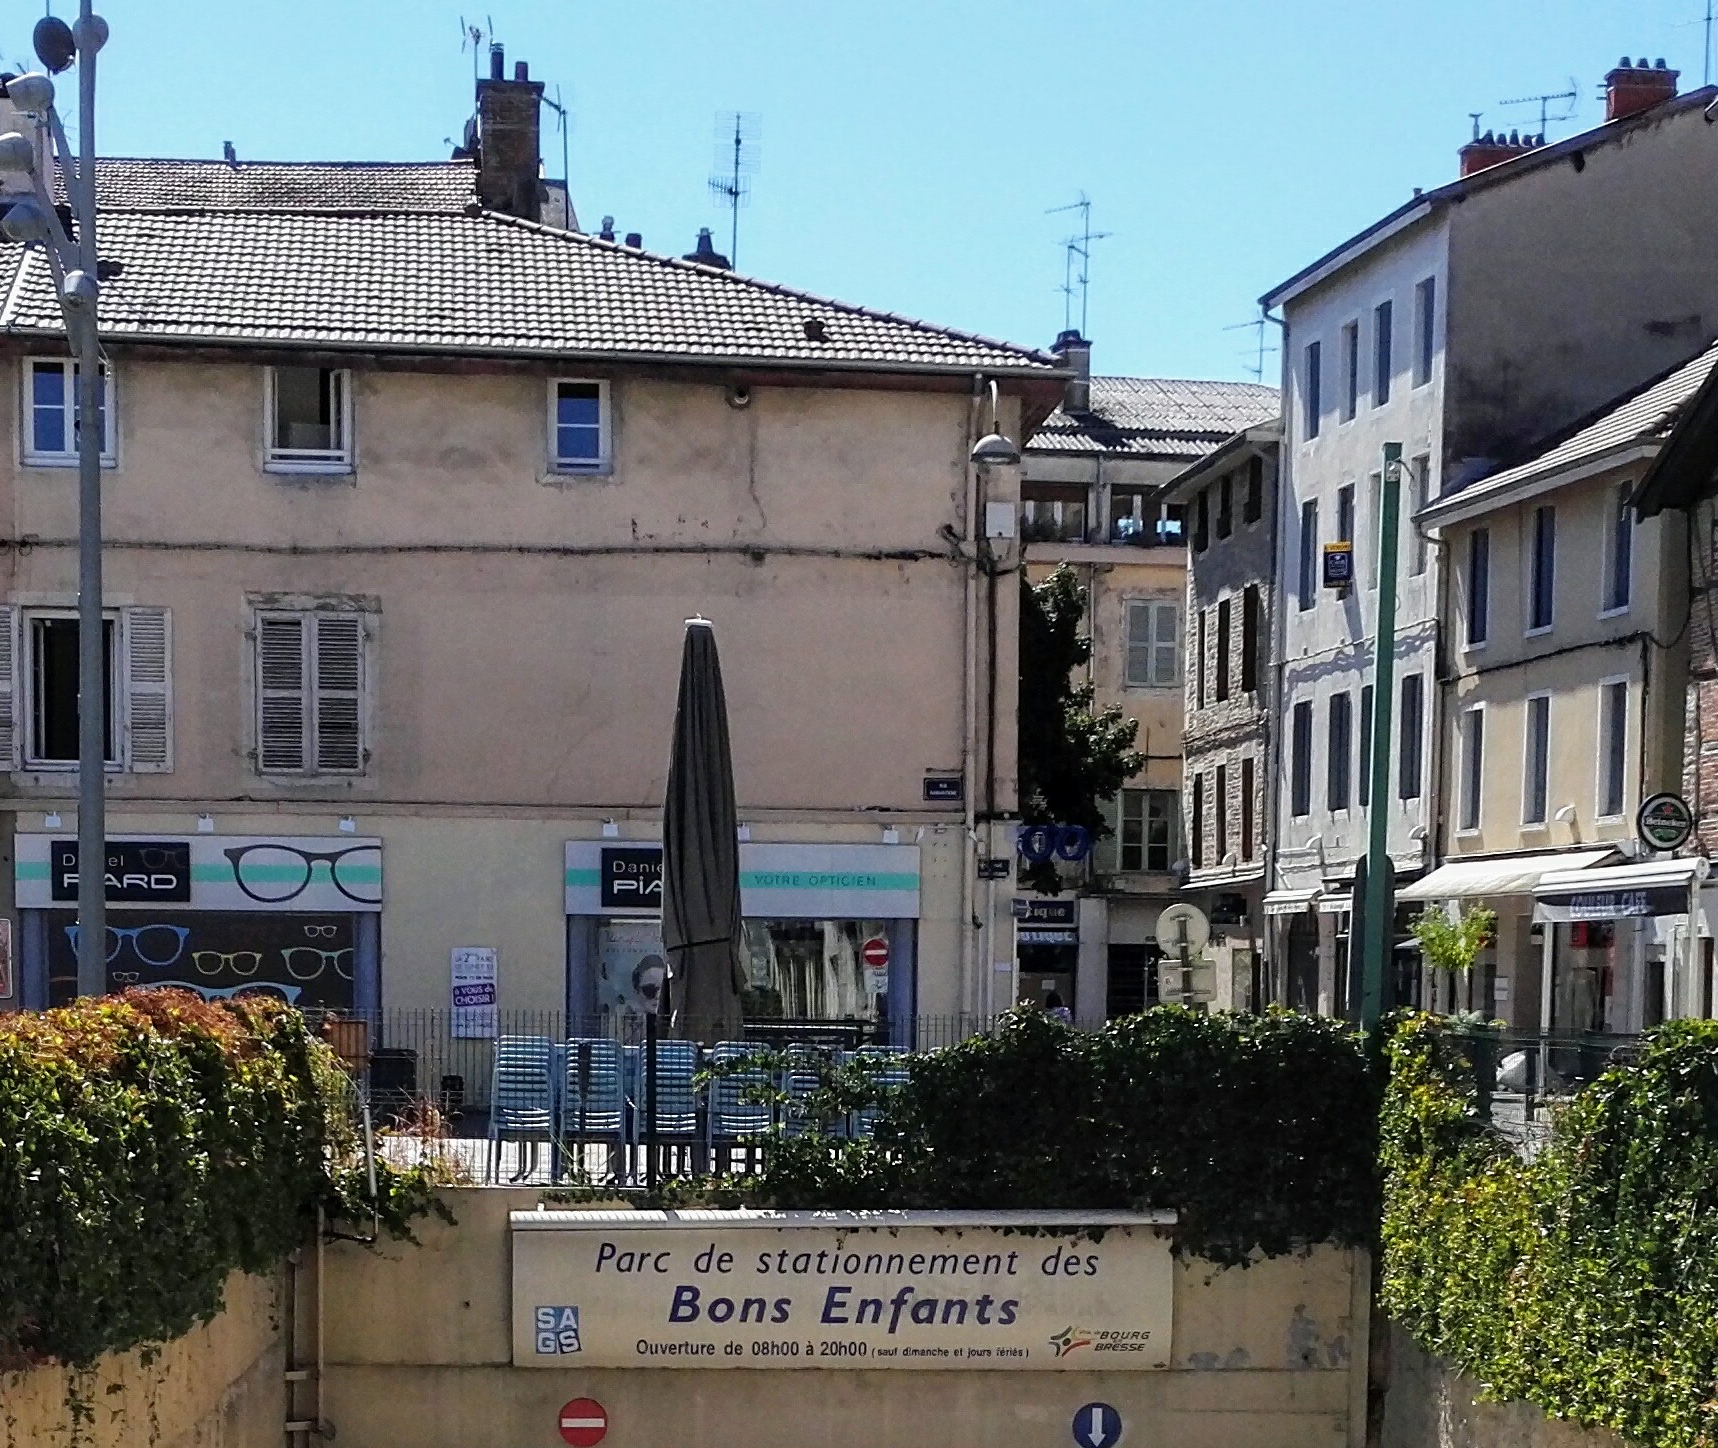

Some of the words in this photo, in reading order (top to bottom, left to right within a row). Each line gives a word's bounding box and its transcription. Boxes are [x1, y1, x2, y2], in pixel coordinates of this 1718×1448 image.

[63, 853, 124, 867] Del
[63, 873, 177, 889] PARD
[754, 875, 801, 887] VOTRE
[808, 875, 877, 887] OPTICIEN
[595, 1242, 671, 1273] Parc
[693, 1243, 734, 1274] de
[756, 1248, 1019, 1275] stationnement
[1041, 1245, 1100, 1276] des
[668, 1285, 792, 1324] Bons
[820, 1286, 1020, 1334] Enfants
[1099, 1331, 1151, 1340] BOURG
[636, 1339, 716, 1356] Ouverture
[723, 1340, 744, 1356] de
[752, 1340, 799, 1356] 08h00
[806, 1340, 814, 1356] à
[820, 1341, 868, 1357] 20h00
[902, 1346, 950, 1357] dimanche
[953, 1347, 963, 1357] et
[967, 1346, 992, 1358] jours
[1094, 1342, 1146, 1352] BRESSE
